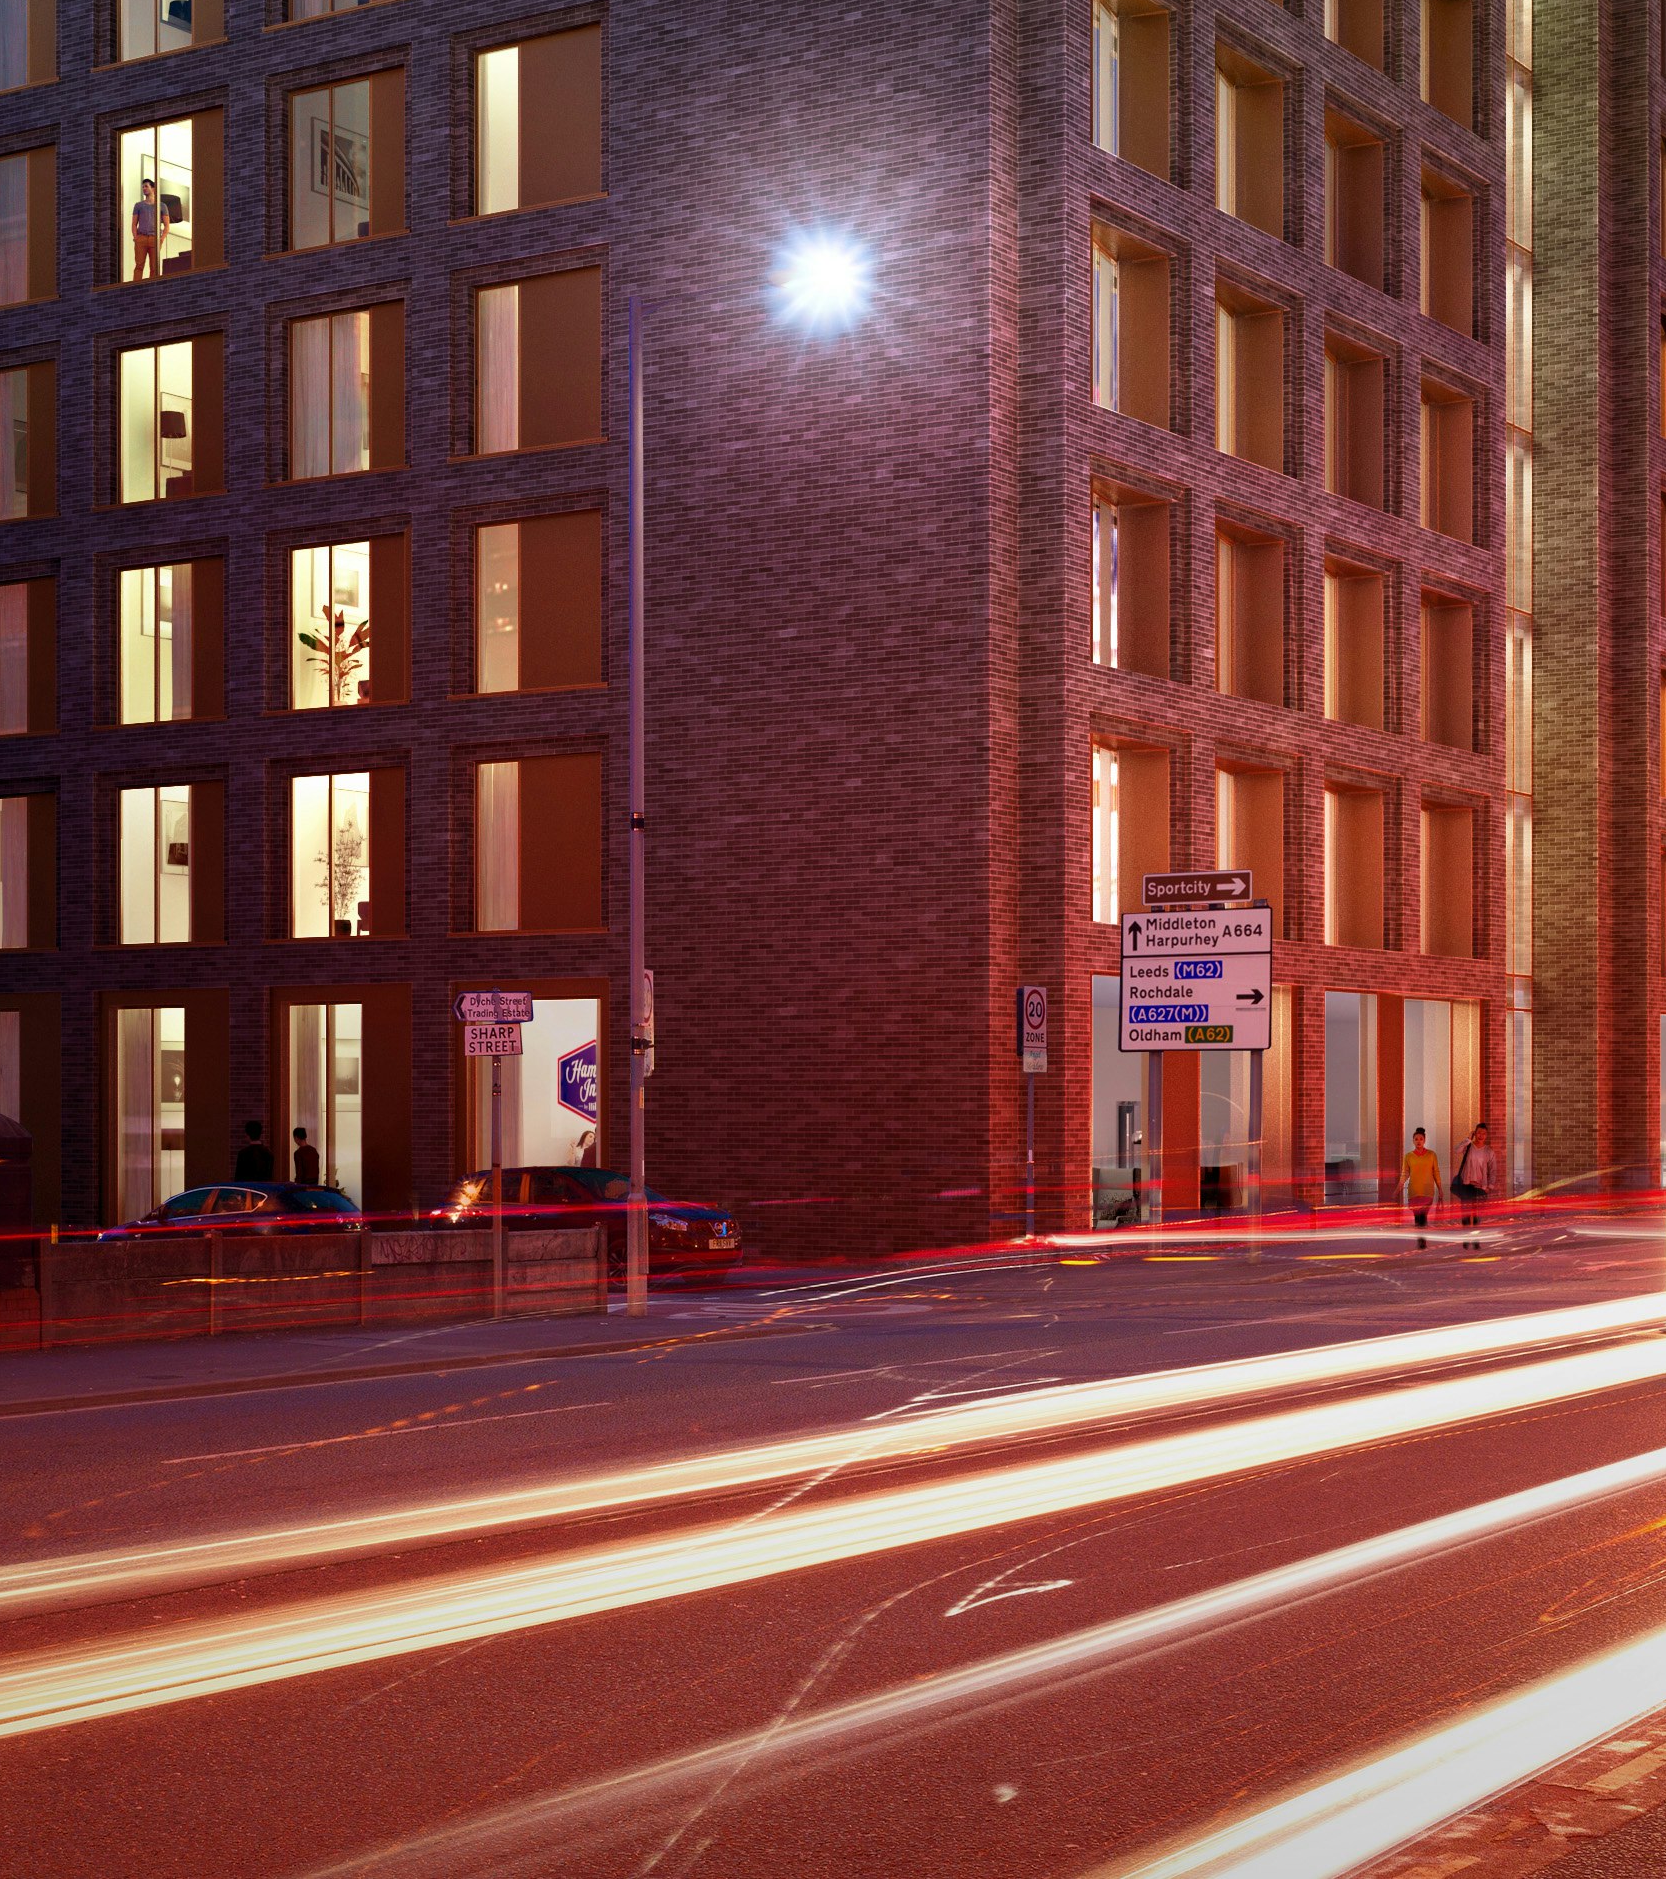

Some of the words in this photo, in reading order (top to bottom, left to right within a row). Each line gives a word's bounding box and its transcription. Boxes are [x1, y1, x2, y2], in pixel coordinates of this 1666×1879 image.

[1147, 880, 1211, 898] Sportcity
[1146, 918, 1216, 930] Middleton
[1222, 924, 1263, 938] A664
[1146, 933, 1219, 948] Harpurhey
[1130, 965, 1169, 978] Leeds
[1175, 963, 1221, 978] (M62)
[1130, 985, 1193, 998] Rochdale
[470, 997, 495, 1007] Dyche
[500, 997, 526, 1005] Street
[468, 1009, 498, 1018] Trading
[1028, 1001, 1042, 1017] 20
[1130, 1006, 1208, 1022] (A627(M))
[471, 1027, 514, 1039] SHARP
[1026, 1032, 1044, 1042] ZONE
[1129, 1028, 1182, 1042] Oldham
[1187, 1026, 1231, 1042] (A62)
[469, 1040, 516, 1052] STREET
